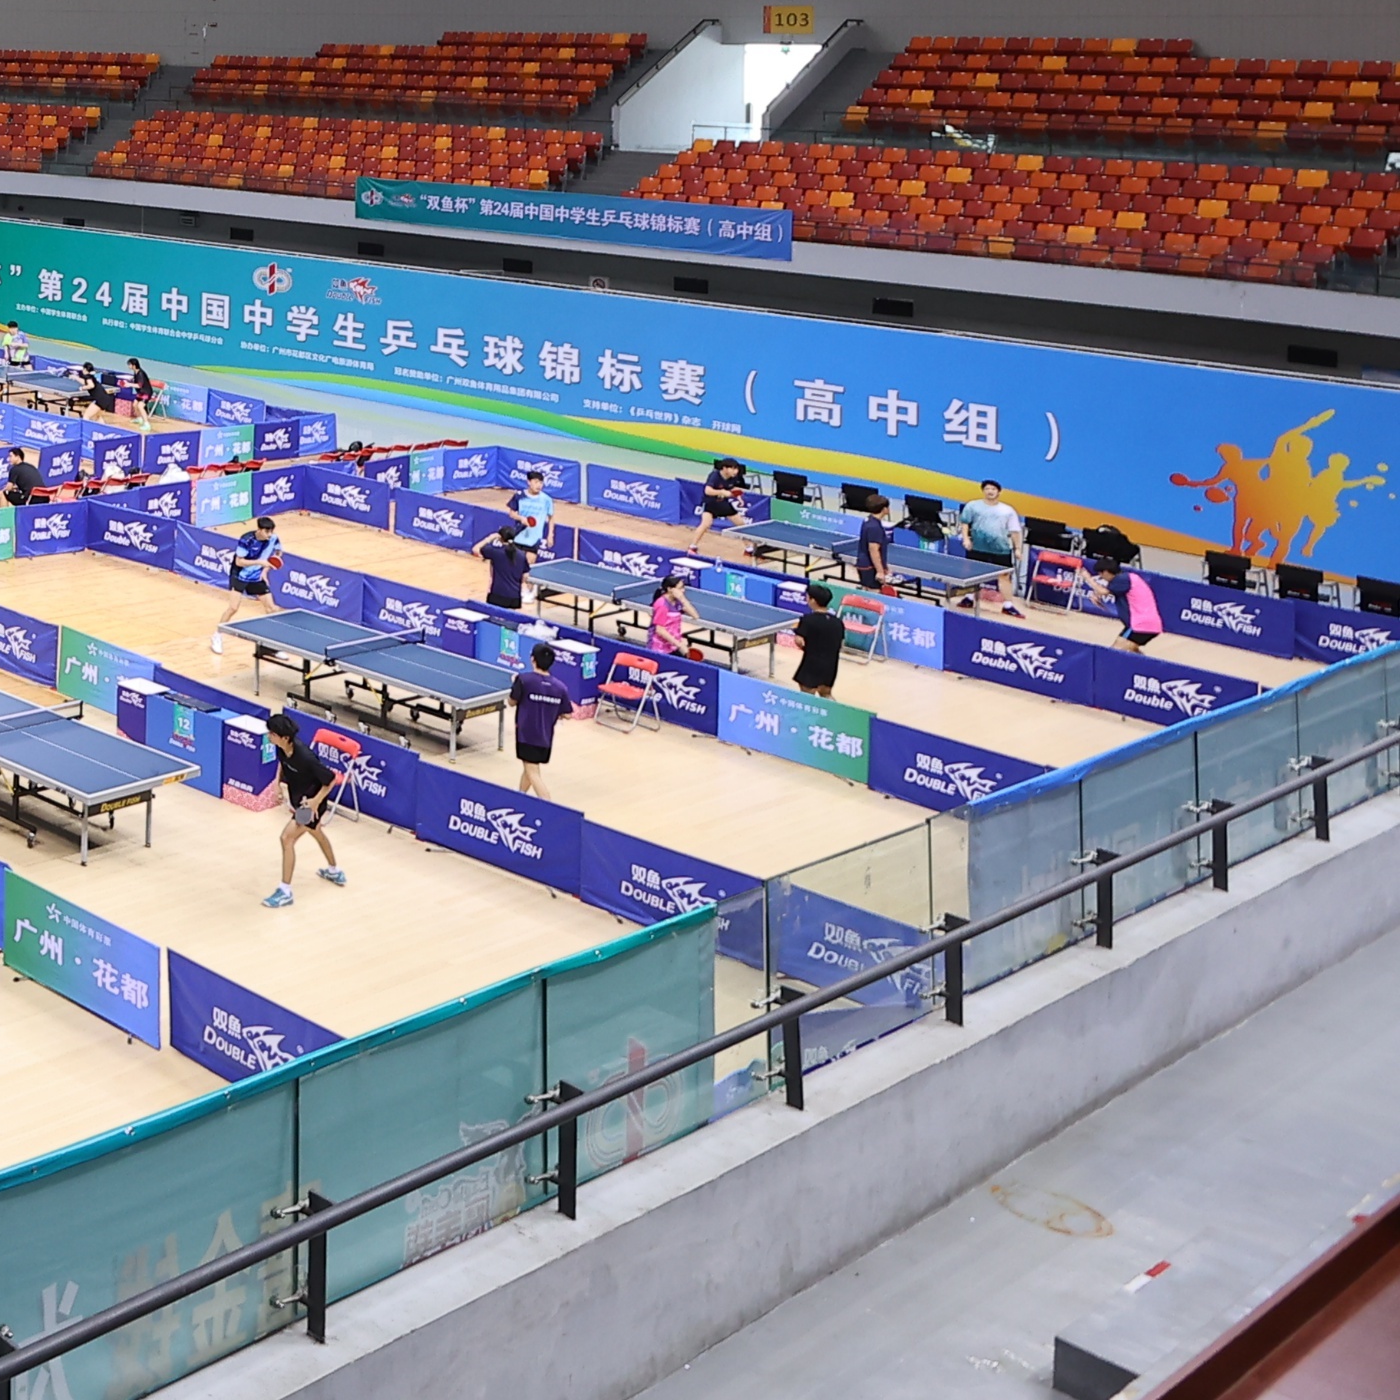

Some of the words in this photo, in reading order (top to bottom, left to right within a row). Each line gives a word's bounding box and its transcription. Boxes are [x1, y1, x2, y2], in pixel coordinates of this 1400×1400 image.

[774, 12, 809, 28] 103
[420, 192, 784, 243] “双鱼杯”第24届中国中学生乒乓球锦标赛（高中组）
[140, 540, 159, 554] FISH
[1181, 609, 1225, 630] DOUBLE
[1236, 621, 1262, 638] FISH
[504, 638, 516, 650] 14
[1318, 634, 1368, 655] DOUBLE
[971, 651, 1017, 674] Double
[1034, 666, 1065, 685] FISH
[679, 699, 706, 716] FISH
[1123, 688, 1174, 712] Double
[176, 716, 191, 731] 12
[729, 702, 864, 759] 广州·花都
[904, 768, 957, 796] DOUBLE
[447, 814, 499, 846] DOUBLE
[513, 838, 544, 861] FISH
[620, 878, 675, 916] DOUBLE
[62, 912, 112, 947] 中国体育彩票
[13, 917, 151, 1010] 广州·花都
[203, 1023, 257, 1073] DOUBLE
